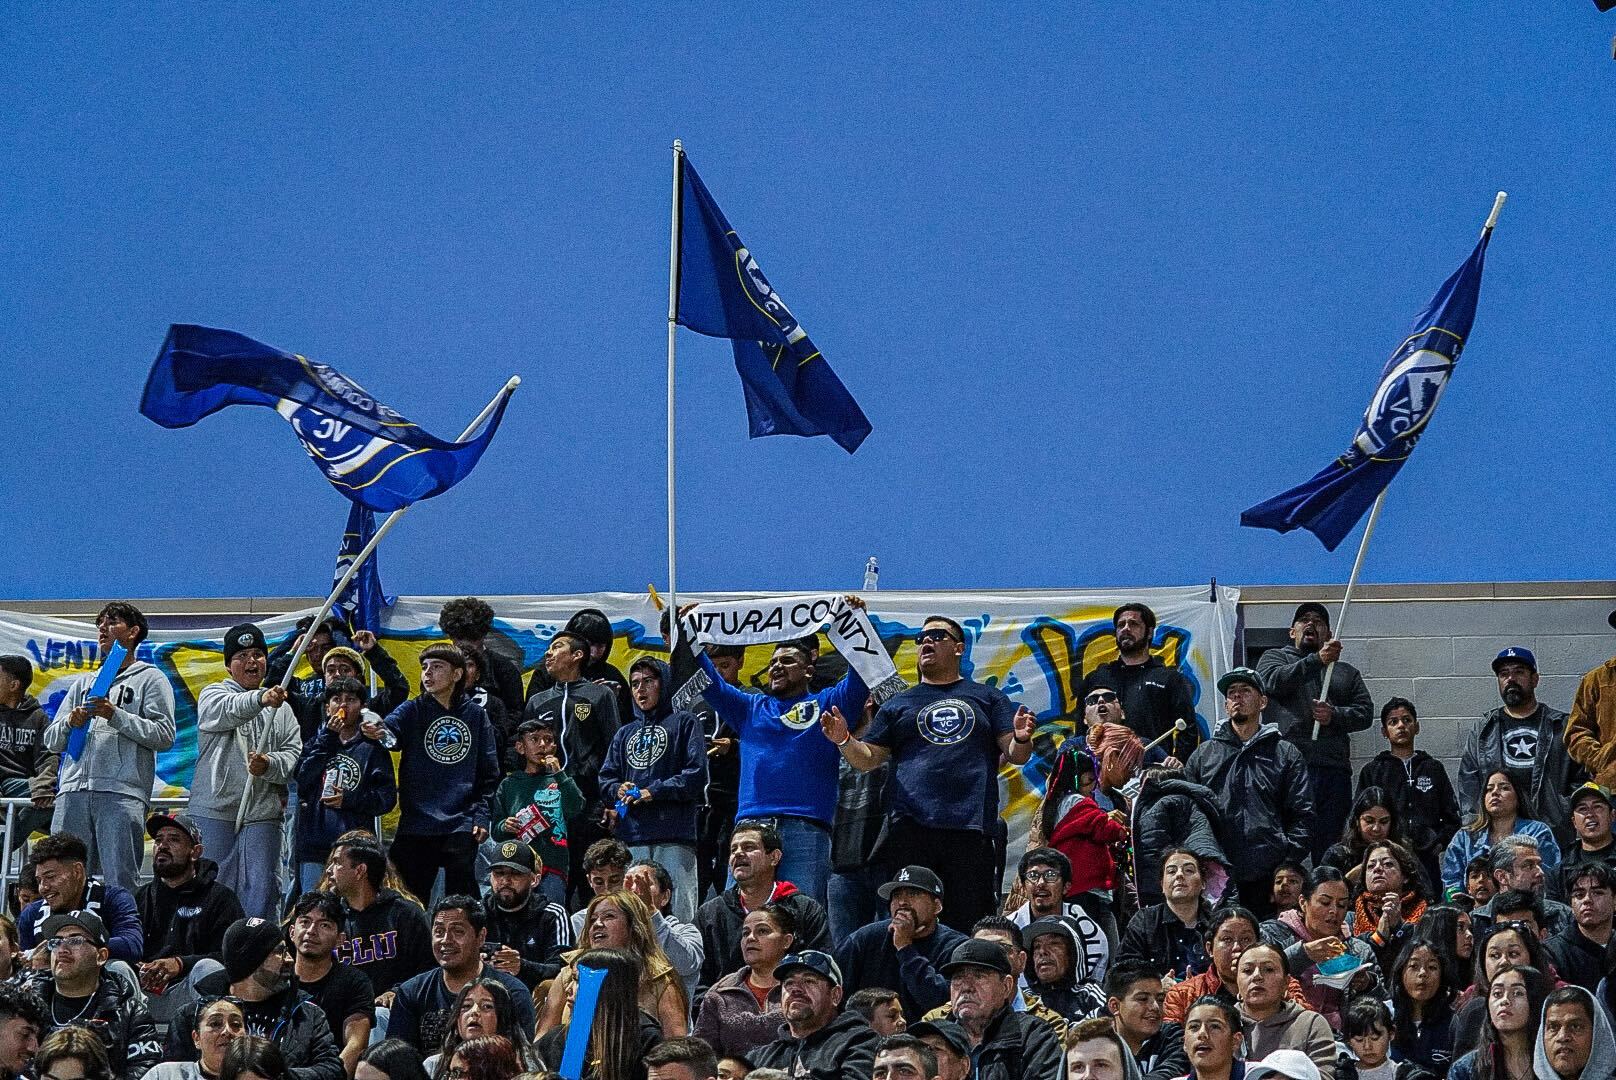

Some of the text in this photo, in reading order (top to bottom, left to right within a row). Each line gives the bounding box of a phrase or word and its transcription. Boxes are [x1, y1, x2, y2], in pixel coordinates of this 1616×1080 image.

[688, 605, 784, 636] NTURA
[940, 720, 953, 728] VC
[15, 728, 36, 745] DIEG
[898, 868, 910, 882] LA
[331, 930, 398, 965] CLU
[127, 1040, 164, 1060] DKN
